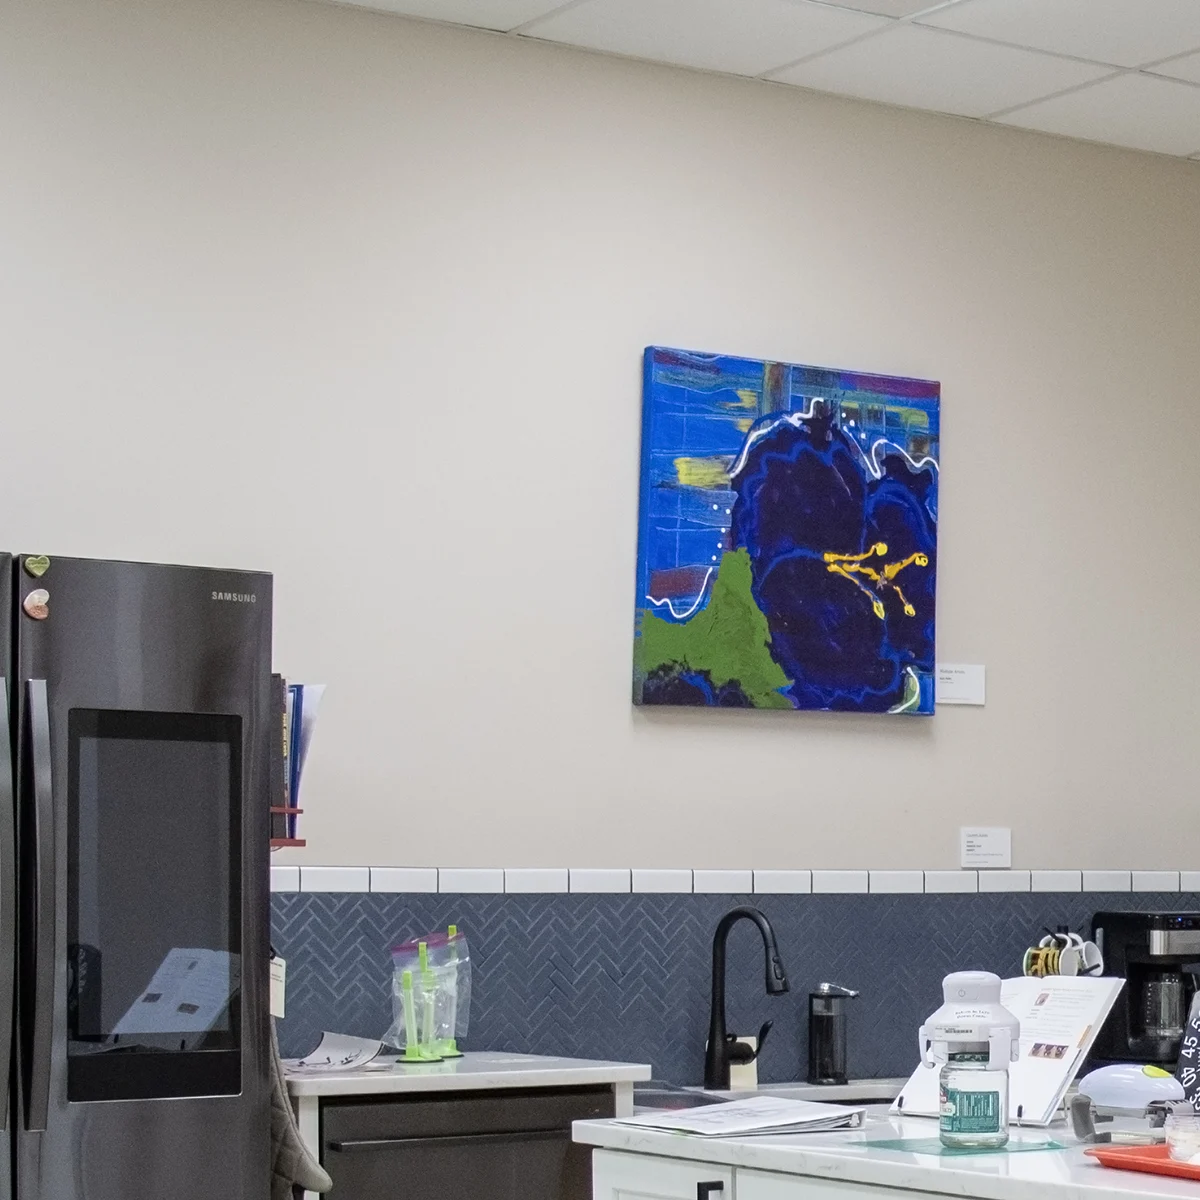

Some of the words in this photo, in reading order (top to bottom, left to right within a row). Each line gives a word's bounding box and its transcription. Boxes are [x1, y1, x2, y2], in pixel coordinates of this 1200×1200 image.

[211, 591, 257, 603] SAMSUNG
[1181, 1035, 1198, 1059] 45
[1181, 1067, 1197, 1088] 40
